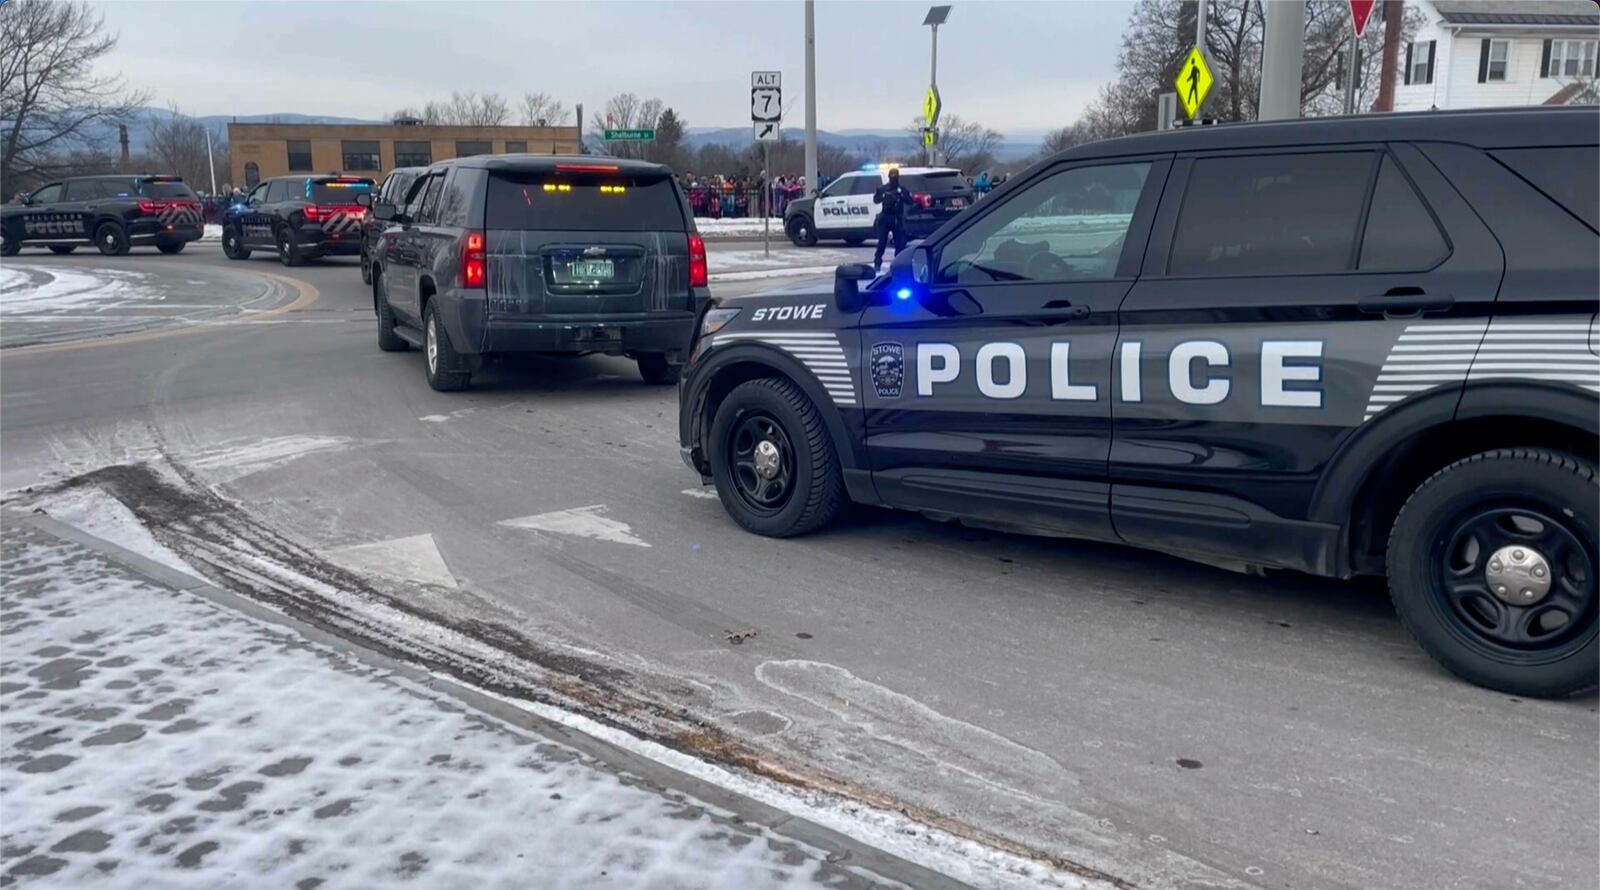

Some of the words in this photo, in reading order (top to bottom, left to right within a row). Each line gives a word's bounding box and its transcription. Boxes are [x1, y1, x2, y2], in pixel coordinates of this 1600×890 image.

[757, 75, 776, 84] ALT
[761, 95, 772, 113] 7
[823, 206, 870, 217] POLICE
[751, 304, 827, 321] STOWE
[872, 344, 902, 355] STOWE
[916, 340, 1326, 409] POLICE
[878, 387, 899, 395] POLICE
